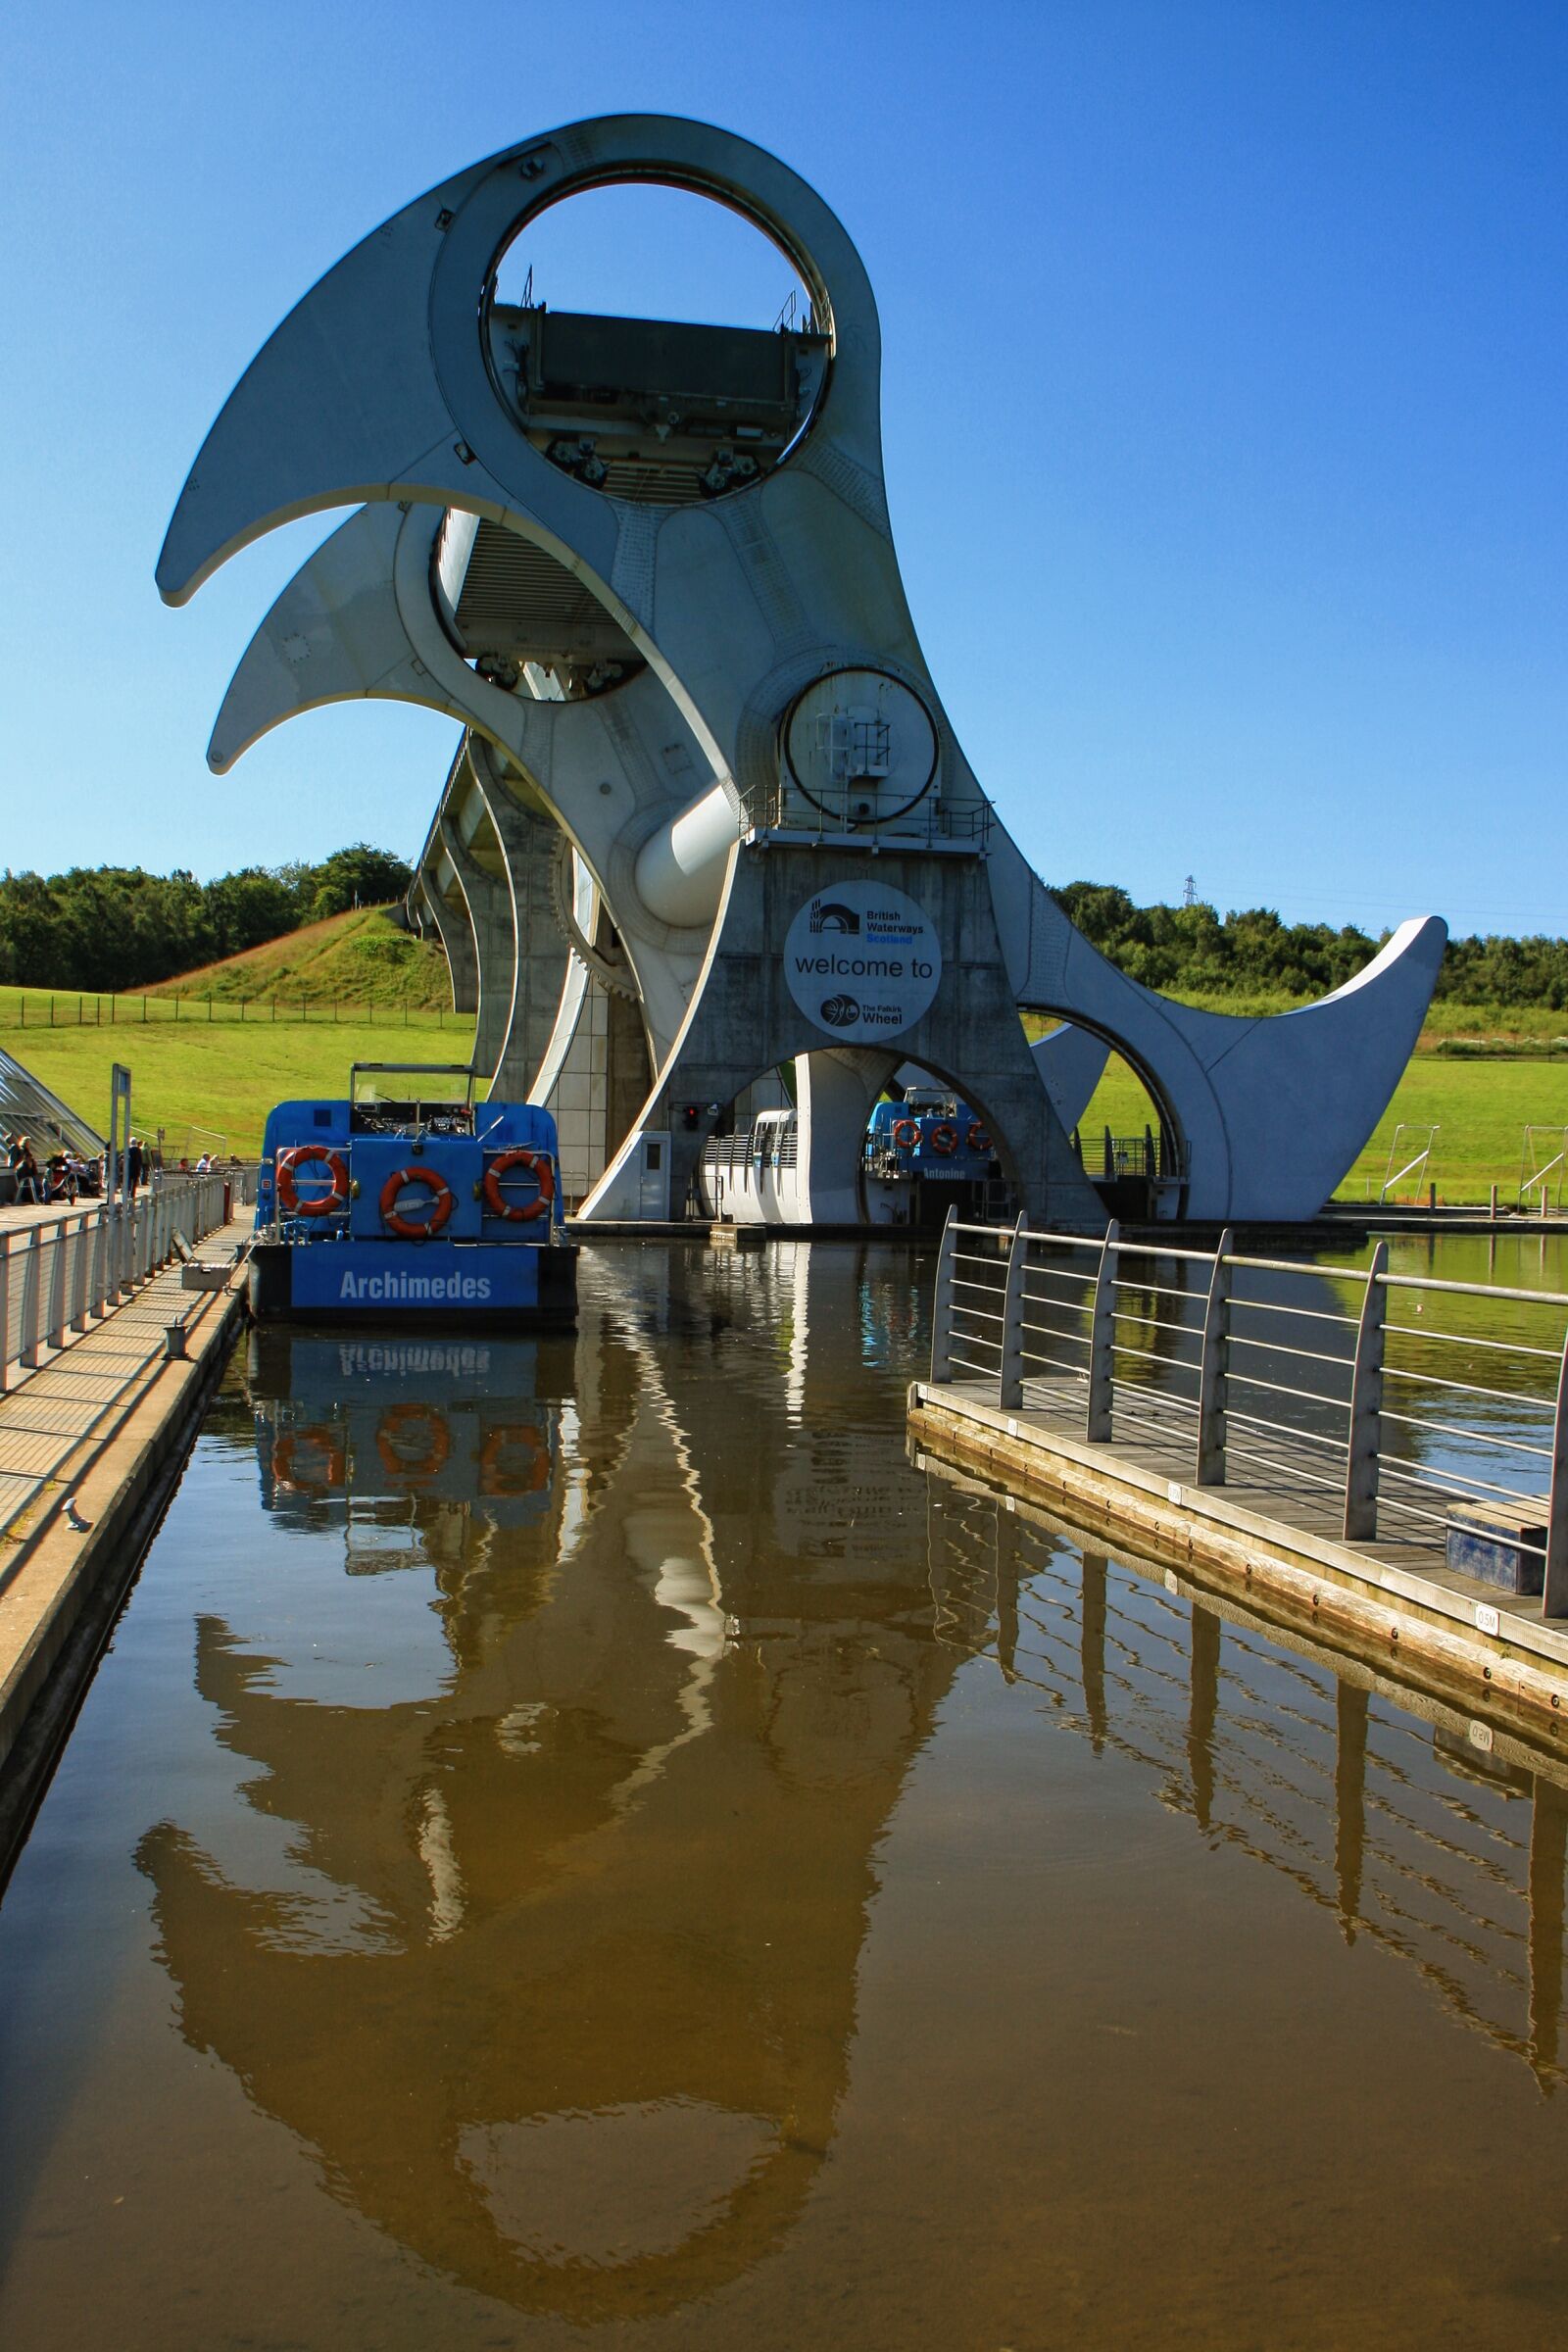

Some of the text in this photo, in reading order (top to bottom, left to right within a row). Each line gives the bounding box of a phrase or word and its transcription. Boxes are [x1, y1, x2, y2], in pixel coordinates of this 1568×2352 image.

[866, 910, 901, 921] British
[866, 922, 924, 934] Waterways
[866, 934, 913, 945] Scotland
[795, 954, 933, 979] welcome to
[877, 1004, 902, 1013] Falkirk
[862, 1013, 903, 1025] Wheel
[923, 1167, 966, 1180] Antonine
[340, 1271, 491, 1299] Archimedes
